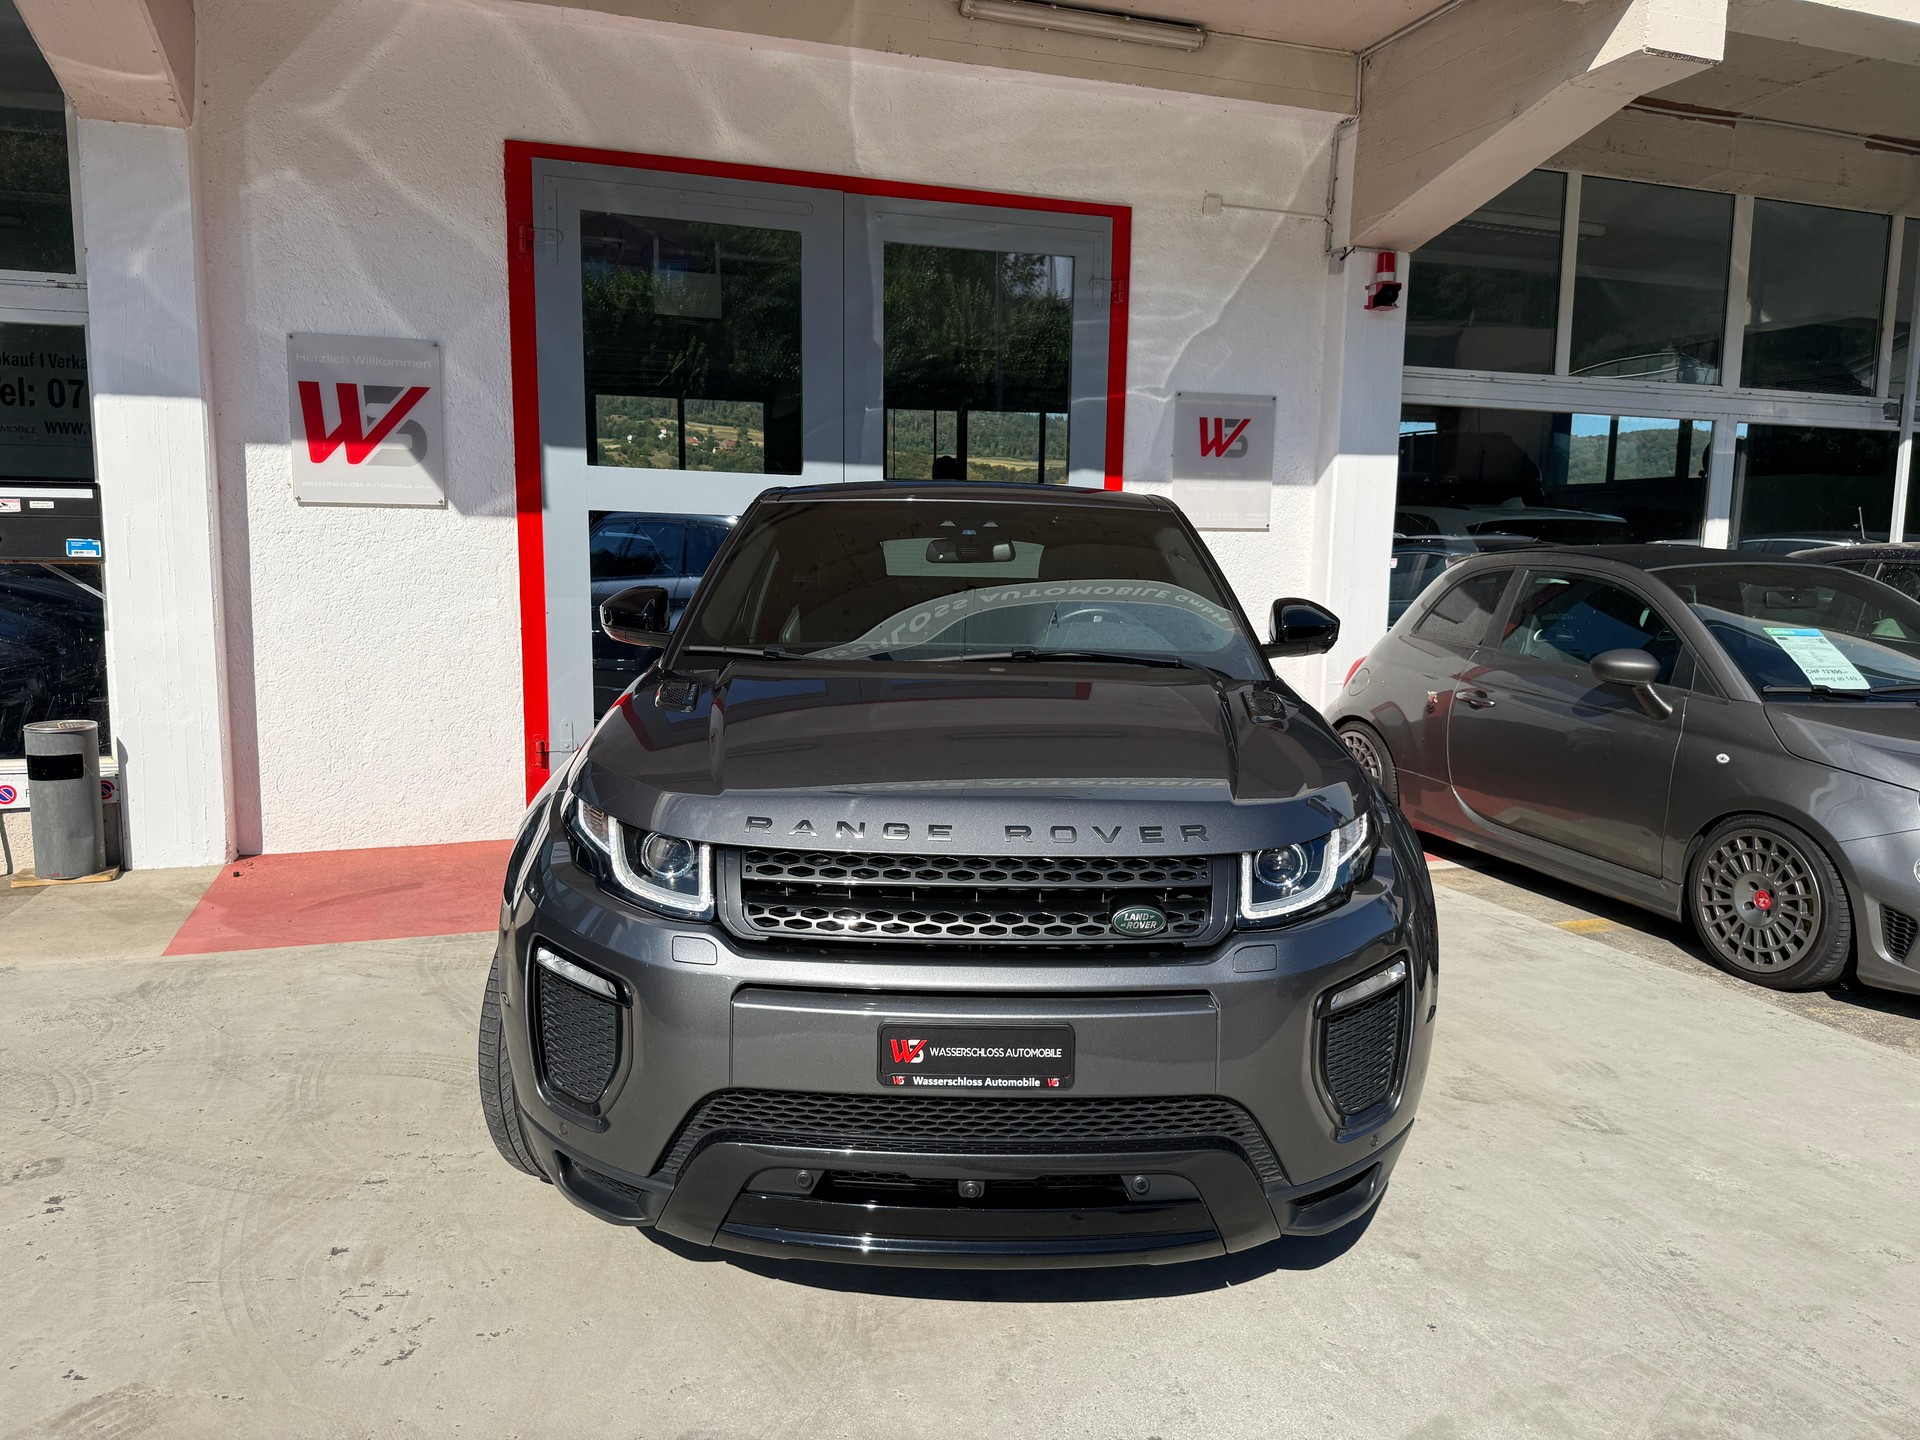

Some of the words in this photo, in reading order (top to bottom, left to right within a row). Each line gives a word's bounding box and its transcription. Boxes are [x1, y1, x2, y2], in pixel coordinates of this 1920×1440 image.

[295, 352, 349, 365] Herzlich
[352, 354, 432, 369] Willkommen
[47, 378, 85, 409] 07
[302, 480, 364, 488] WASSERSCHLOSS
[743, 816, 953, 842] RANGE
[1004, 824, 1210, 844] ROVER
[1124, 913, 1149, 921] LAND
[1126, 921, 1157, 930] ROVER
[929, 1047, 1004, 1058] WASSERSCHLOSS
[1005, 1048, 1062, 1058] AUTOMOBILE
[912, 1076, 983, 1087] Wasserschloss
[984, 1077, 1041, 1087] Automobile
